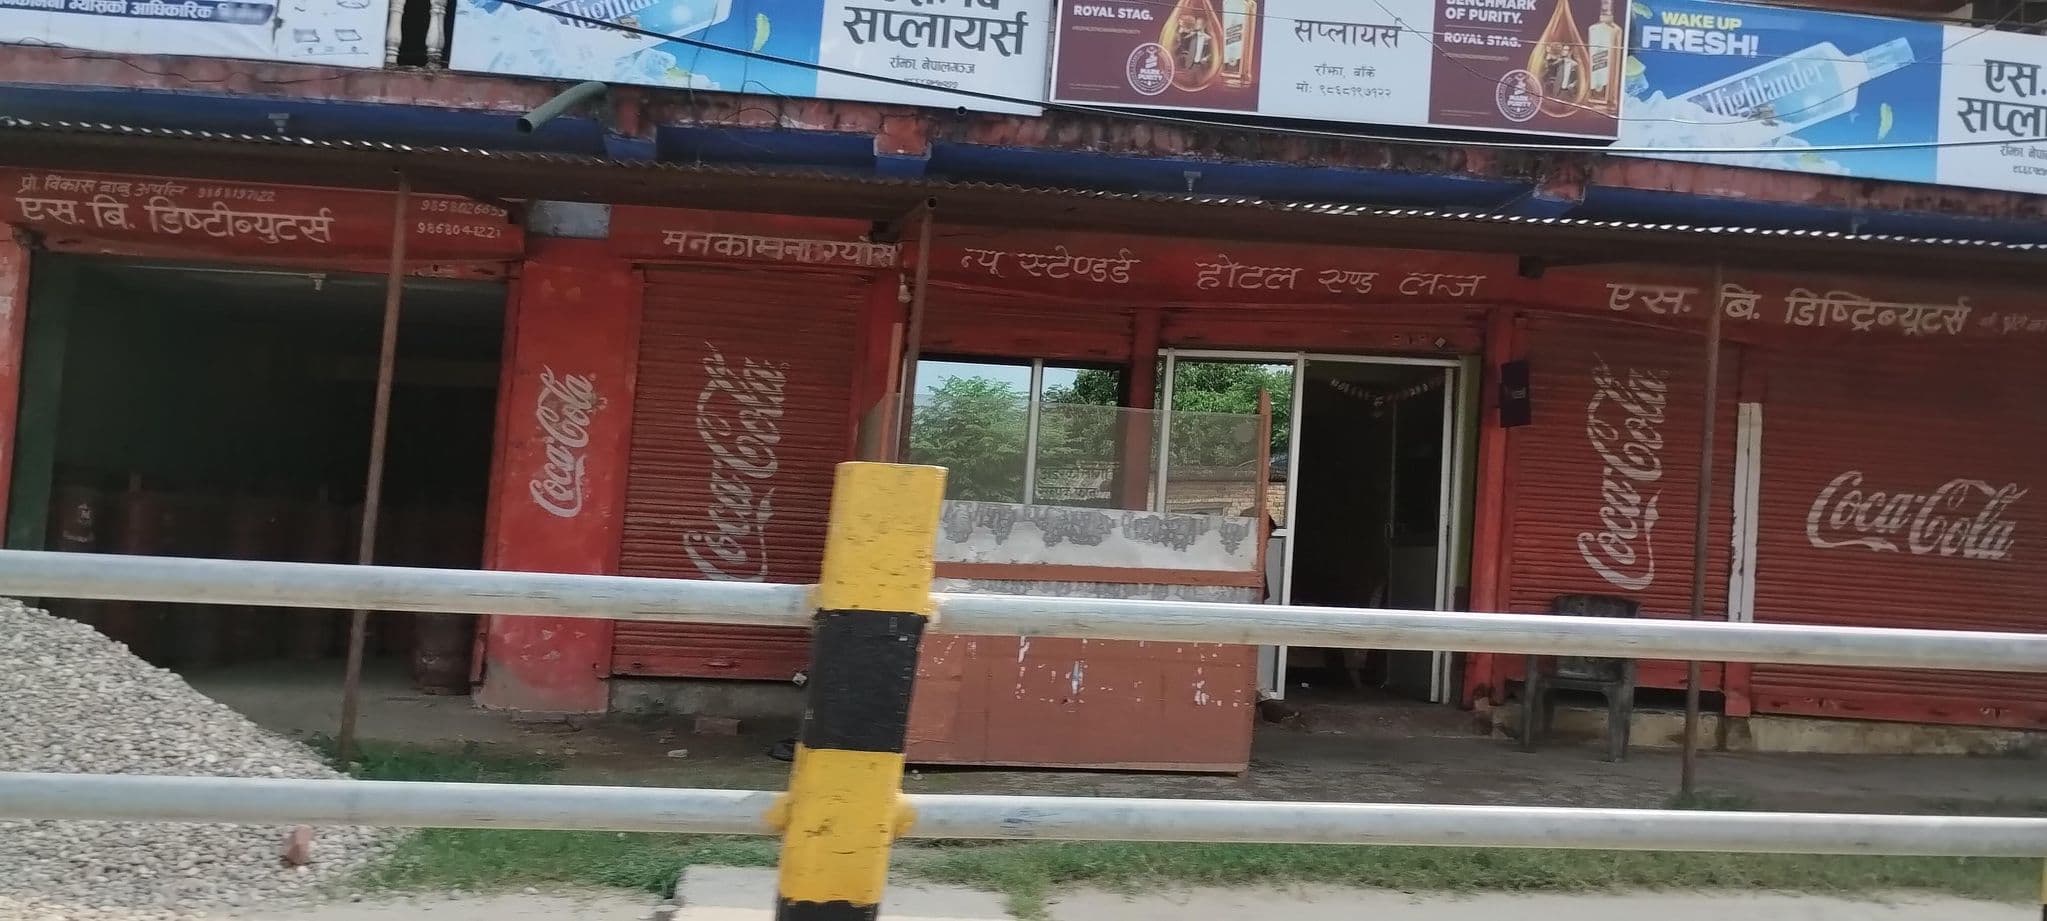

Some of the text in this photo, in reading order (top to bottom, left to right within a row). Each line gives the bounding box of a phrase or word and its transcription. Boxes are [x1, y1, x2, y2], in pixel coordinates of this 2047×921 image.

[1073, 5, 1154, 21] ROYAL STAG.
[1445, 7, 1524, 25] OF PURITY.
[1661, 11, 1742, 30] WAKE UP
[843, 7, 1029, 57] सप्लायर्स
[1294, 17, 1402, 49] सप्लायर्स
[1444, 32, 1522, 48] ROYAL STAG.
[1641, 26, 1760, 57] FRESH!
[1705, 61, 1825, 118] Highlander
[1983, 59, 2047, 98] एस.
[16, 197, 86, 225] एस.
[1195, 253, 1304, 290] होटल
[1606, 282, 1699, 315] एस.
[1805, 470, 2030, 561] Coca-Cola
